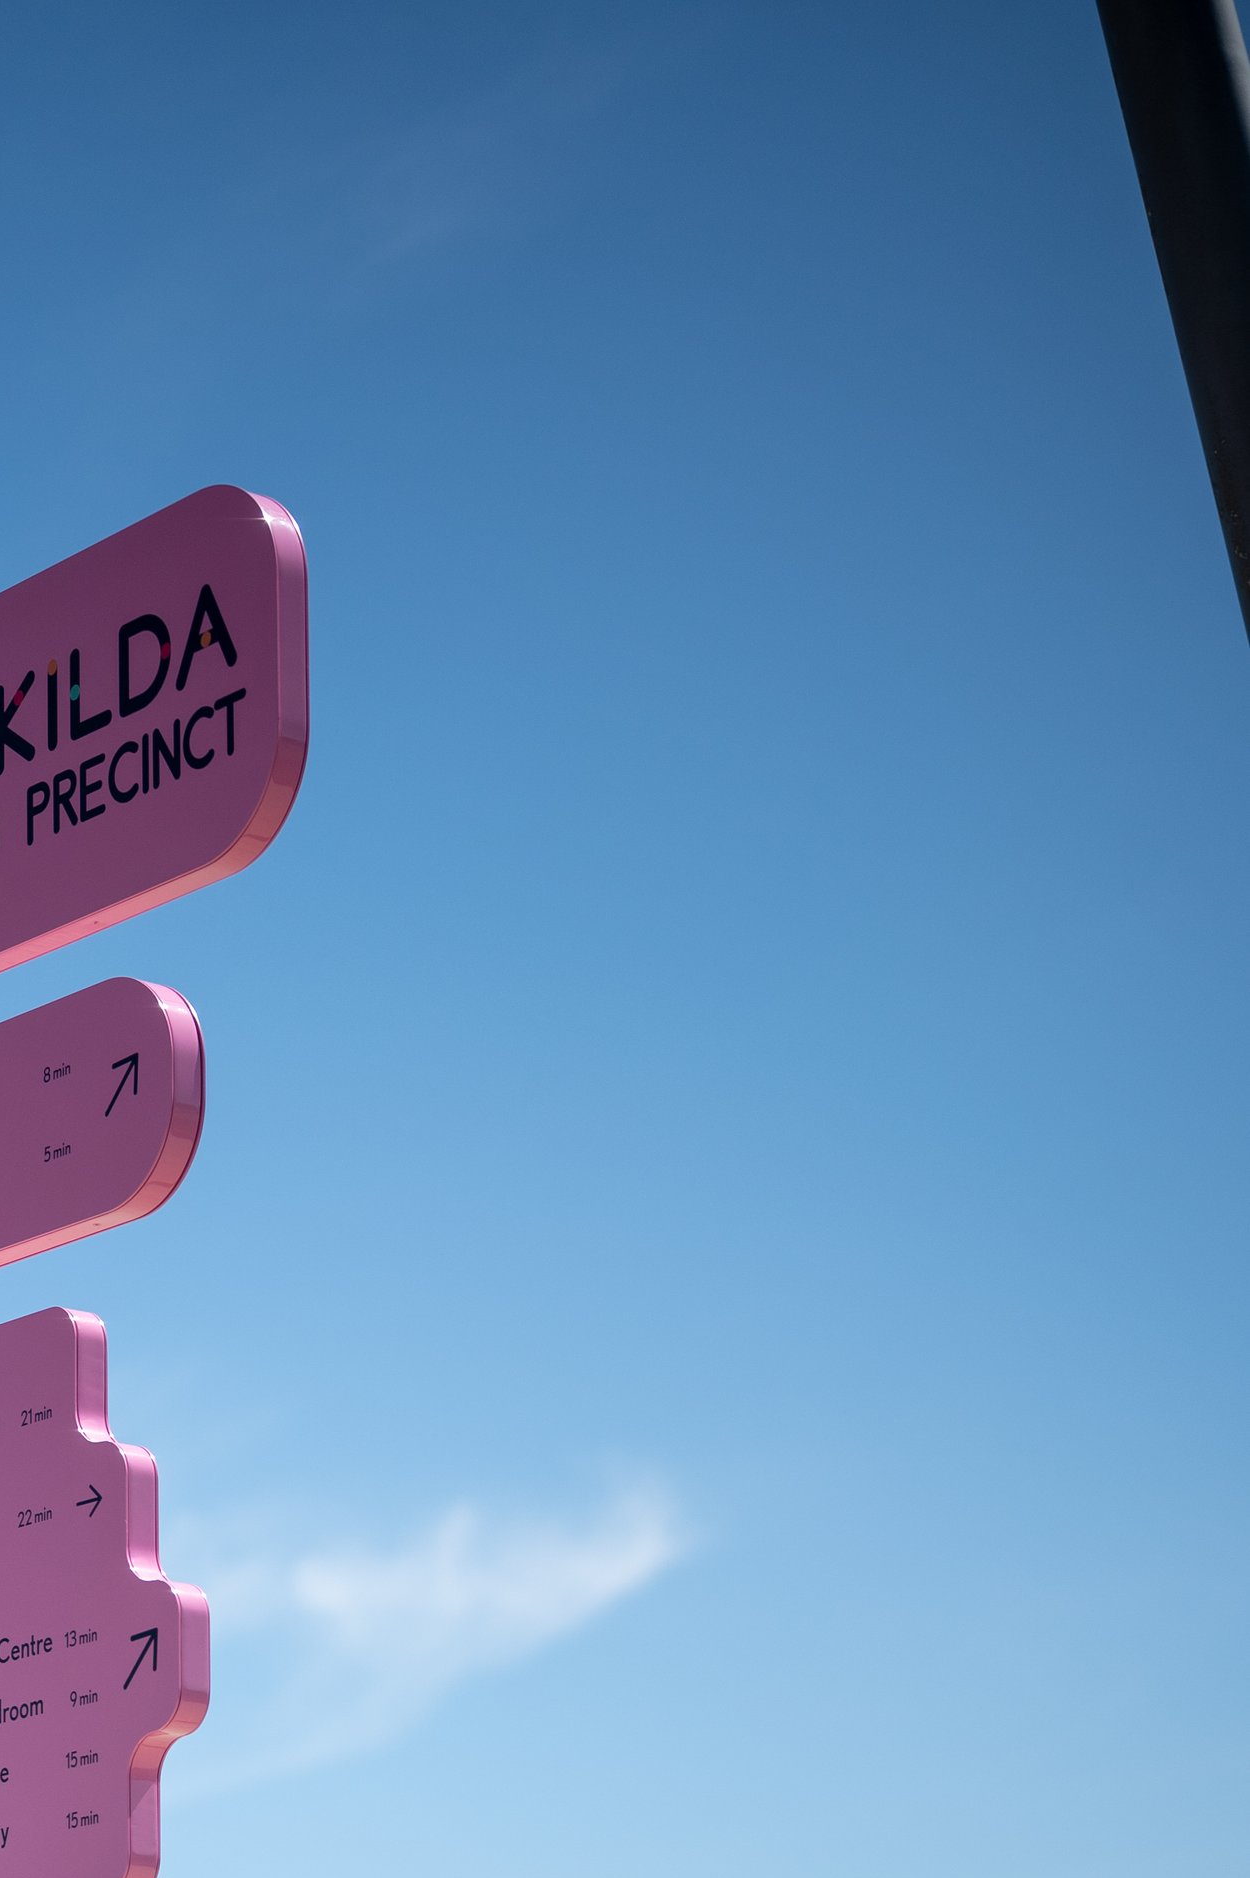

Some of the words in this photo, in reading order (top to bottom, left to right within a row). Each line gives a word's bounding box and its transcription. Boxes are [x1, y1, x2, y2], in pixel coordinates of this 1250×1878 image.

[26, 688, 246, 846] PRECINCT
[43, 1066, 50, 1083] 8
[53, 1063, 71, 1080] min
[44, 1146, 51, 1163] 5
[53, 1142, 71, 1160] min
[21, 1410, 33, 1427] 21
[34, 1406, 52, 1423] min
[18, 1511, 32, 1528] 22
[34, 1507, 52, 1524] min
[64, 1630, 77, 1648] 13
[79, 1627, 98, 1644] min
[70, 1691, 77, 1707] 9
[79, 1690, 98, 1705] min
[66, 1751, 78, 1769] 15
[80, 1750, 98, 1766] min
[66, 1812, 78, 1829] 15
[80, 1810, 99, 1827] min
